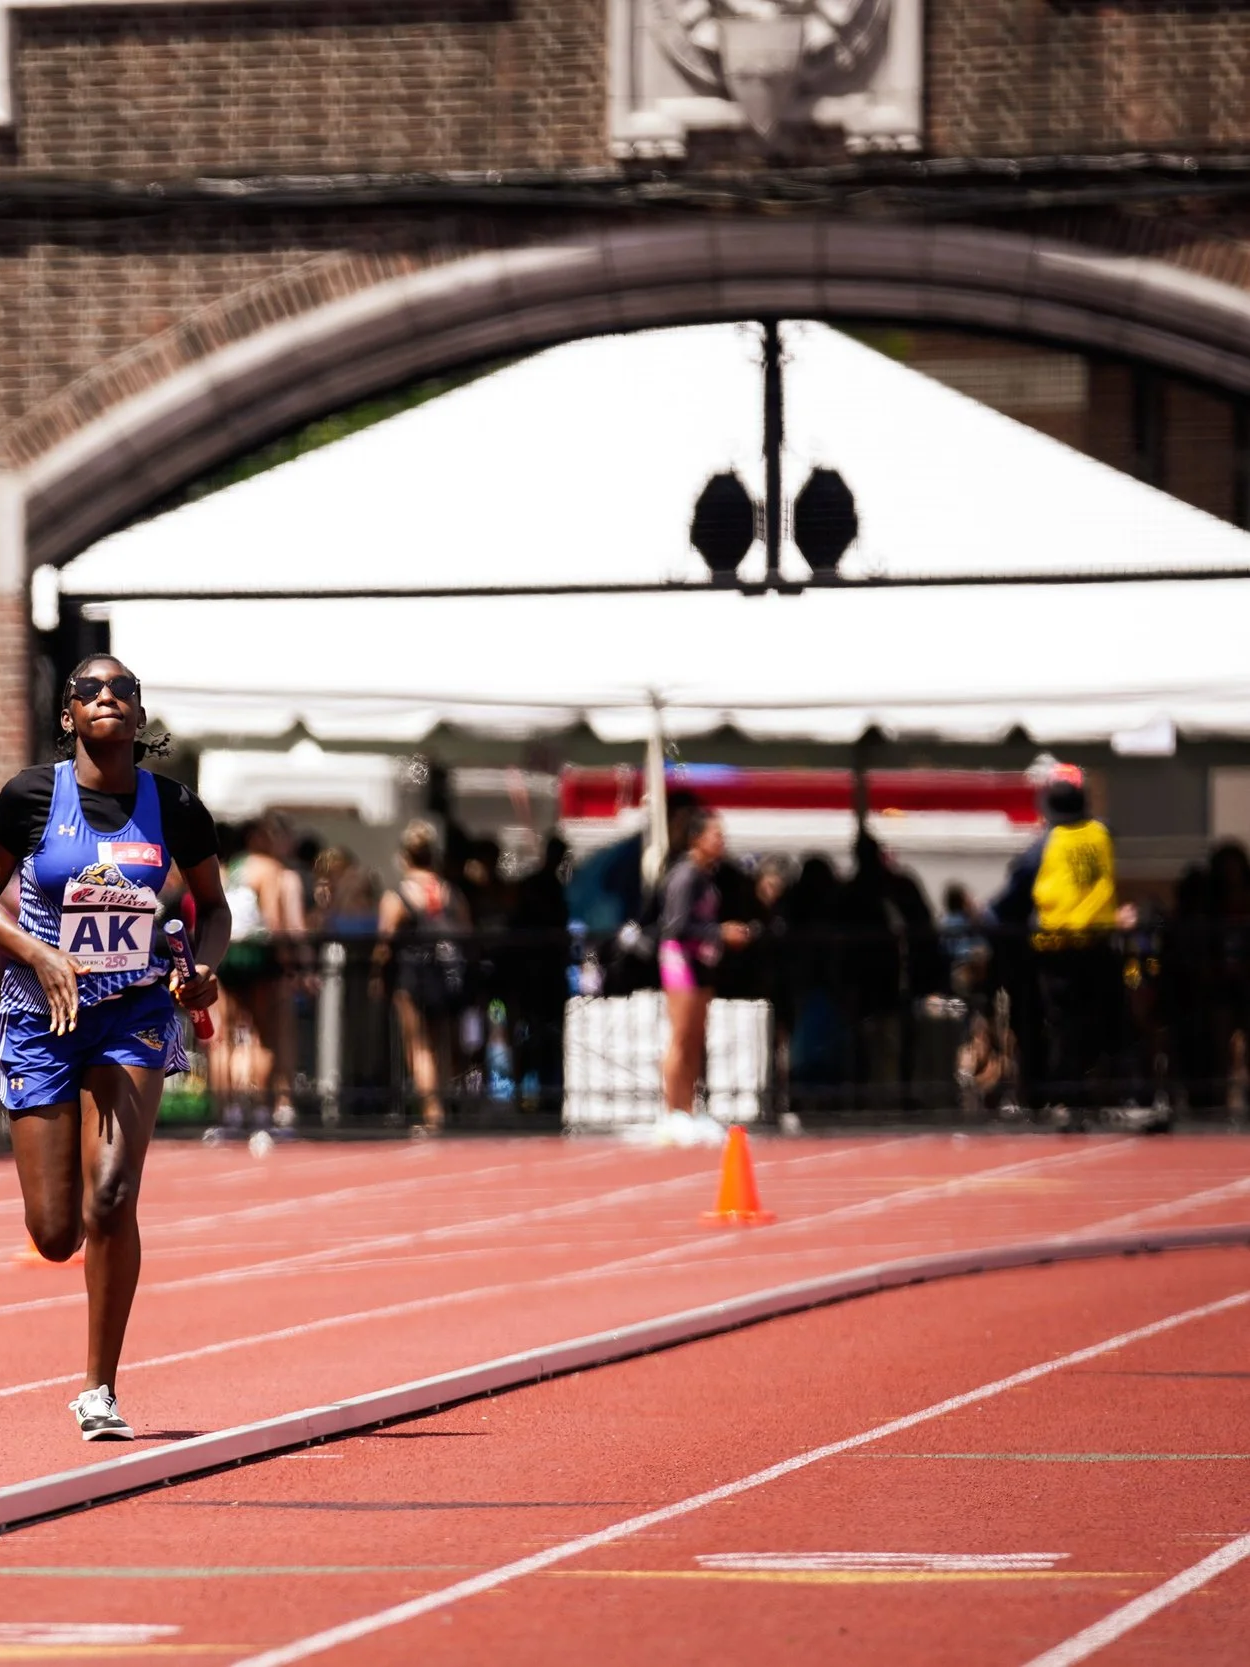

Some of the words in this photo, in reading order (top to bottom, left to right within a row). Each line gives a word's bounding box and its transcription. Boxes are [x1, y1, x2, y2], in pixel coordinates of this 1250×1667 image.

[103, 890, 138, 900] PENN
[99, 897, 148, 907] RELAYS
[69, 915, 141, 953] AK
[105, 954, 128, 969] 250
